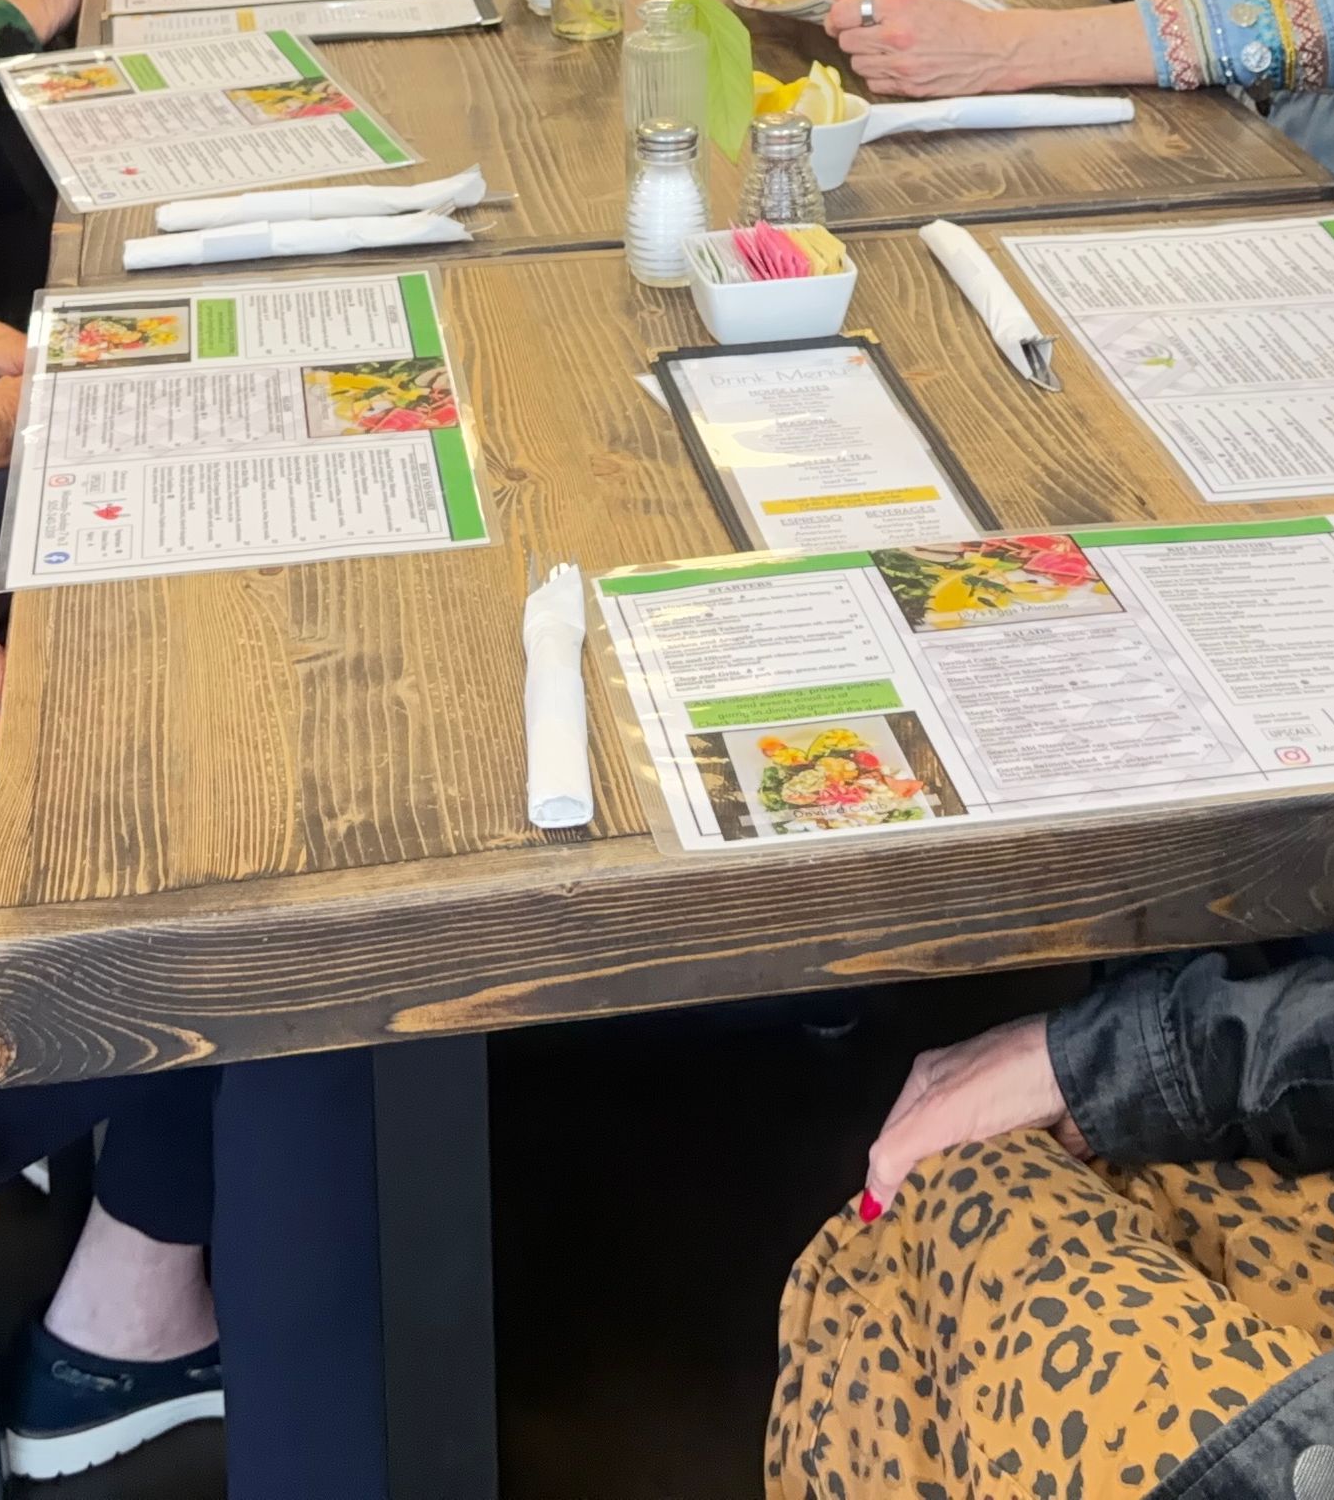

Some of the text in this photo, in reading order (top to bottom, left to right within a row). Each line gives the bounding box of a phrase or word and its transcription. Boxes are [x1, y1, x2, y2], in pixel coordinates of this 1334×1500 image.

[709, 368, 849, 388] Drink Menu
[866, 505, 936, 517] BEVERAGES
[780, 514, 842, 526] ESPRESSO
[709, 581, 773, 595] STARTERS
[1003, 627, 1053, 638] SALADS
[1269, 727, 1313, 737] UPSCALE
[846, 801, 888, 813] Cobb
